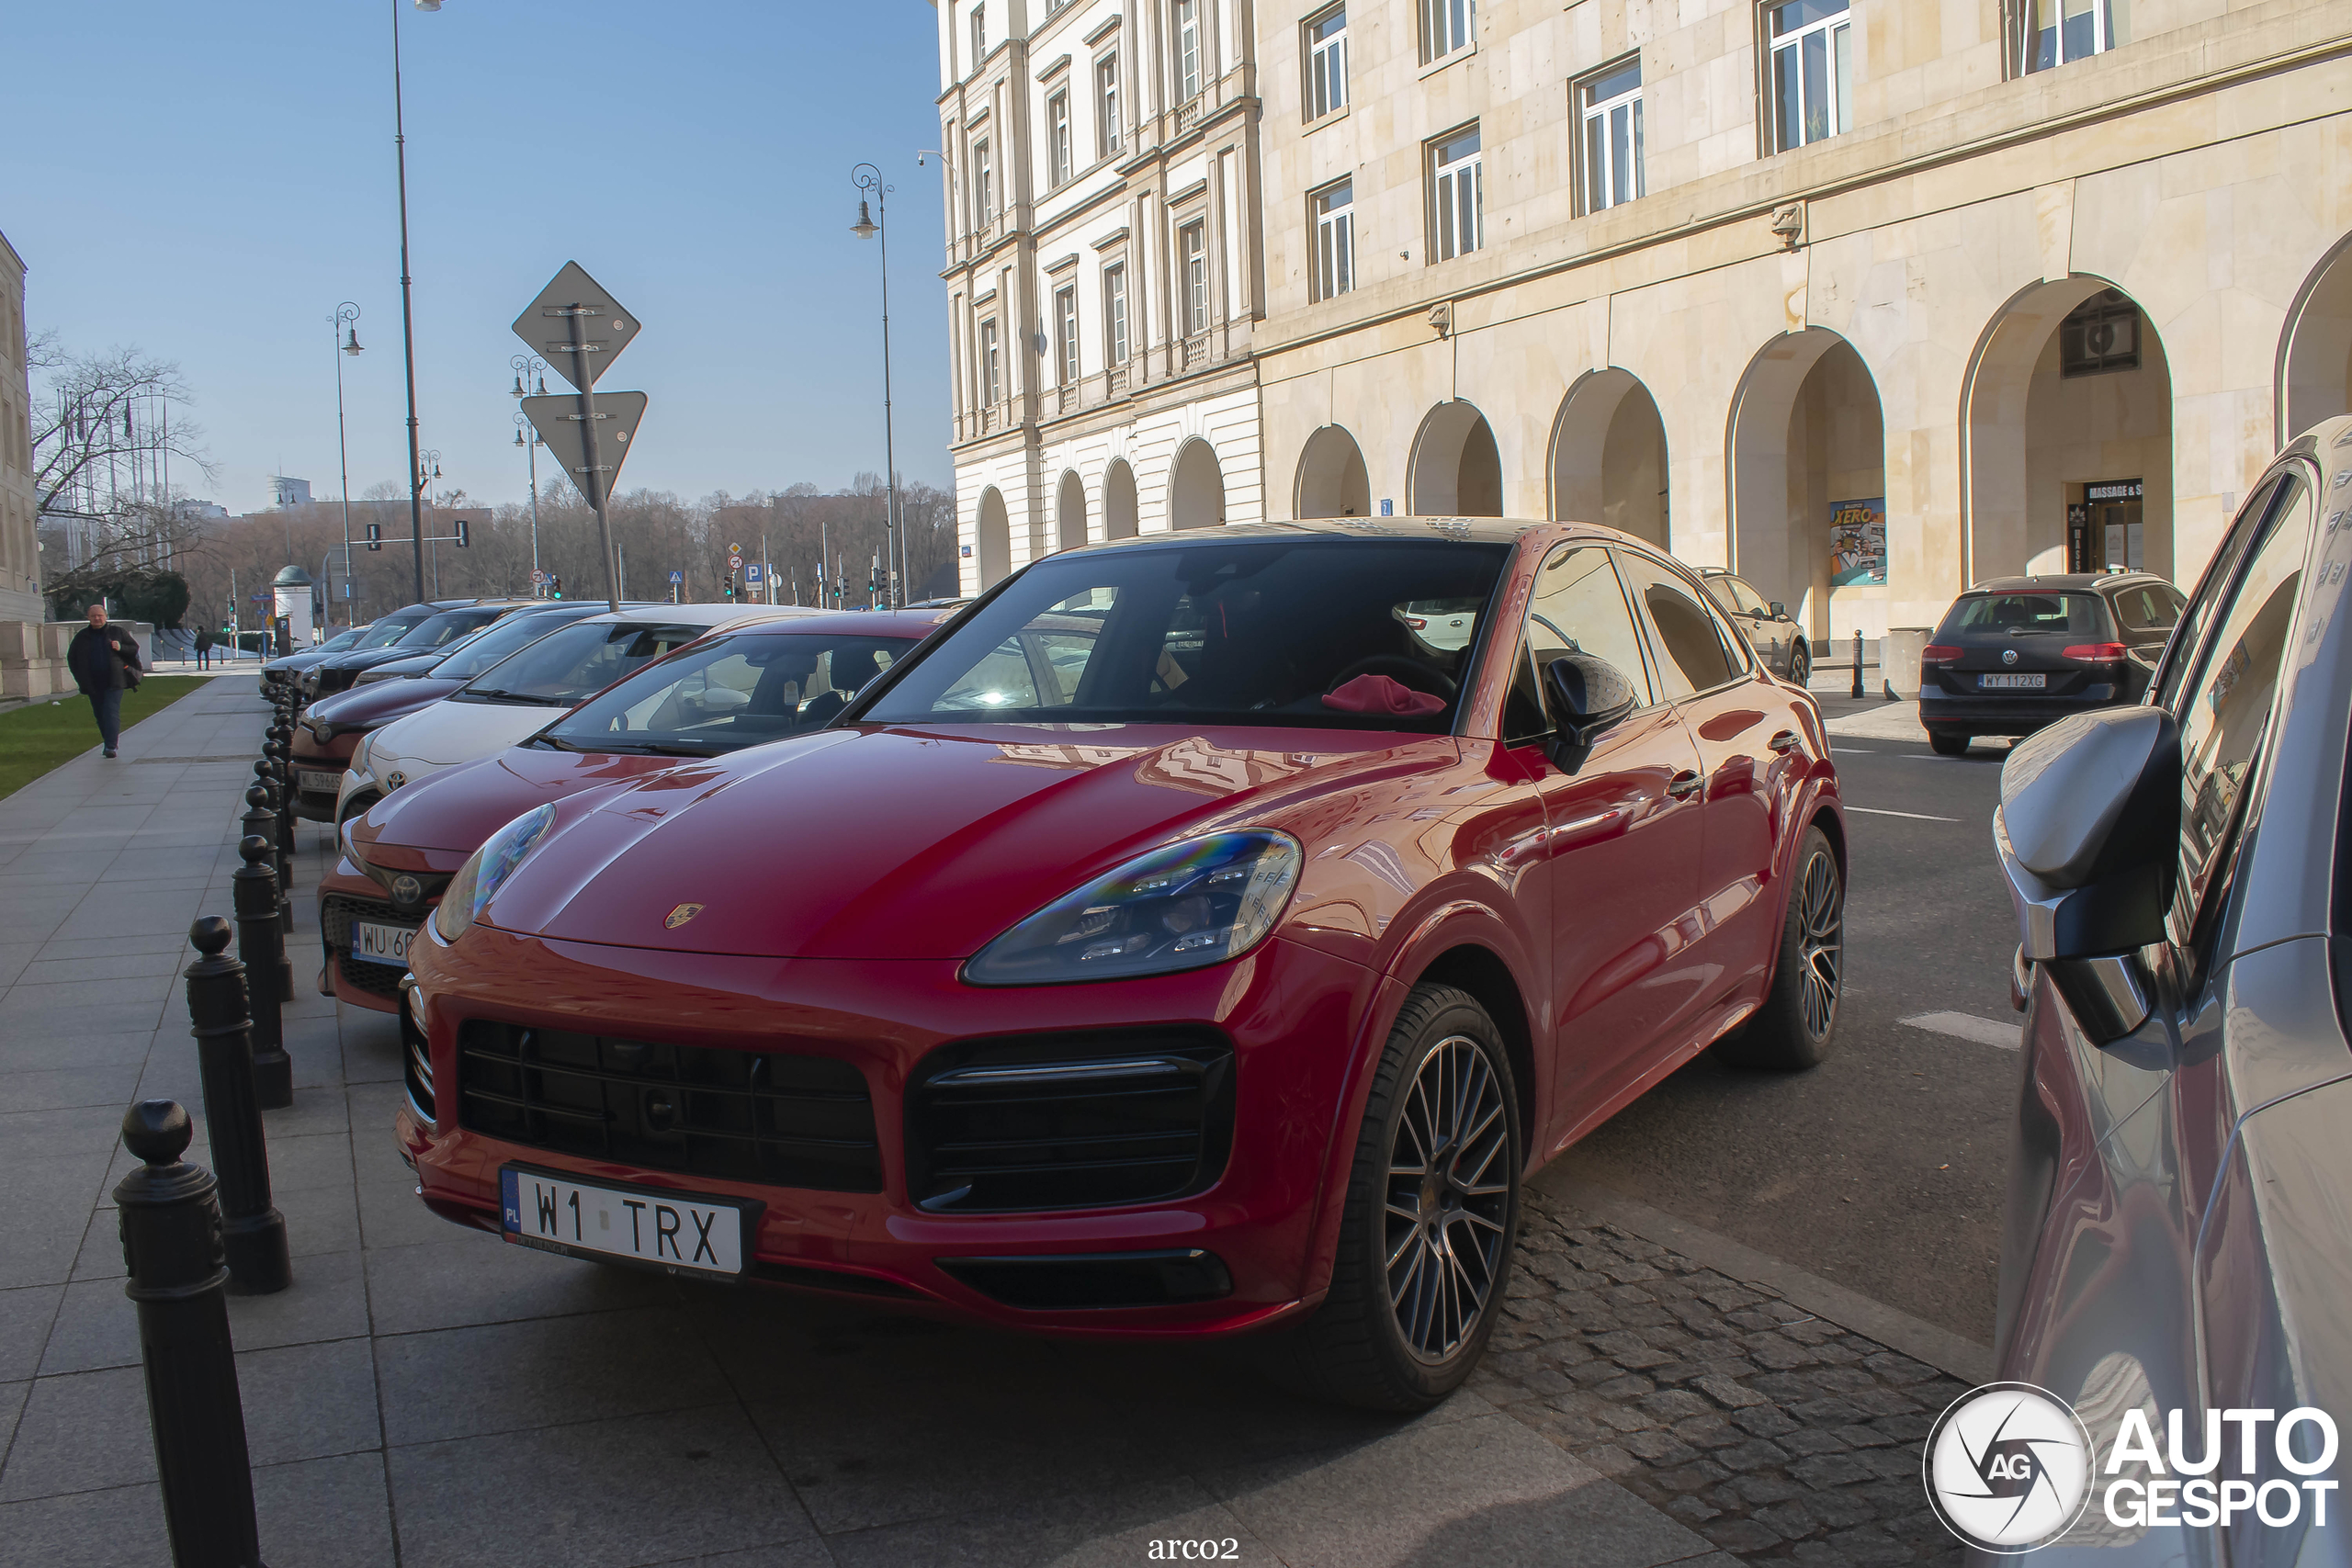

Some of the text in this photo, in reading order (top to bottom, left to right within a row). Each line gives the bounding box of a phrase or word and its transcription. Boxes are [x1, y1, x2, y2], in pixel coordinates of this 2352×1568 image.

[2089, 485, 2127, 499] MASSAGE
[2128, 486, 2135, 496] &
[1835, 508, 1872, 525] XERO
[748, 566, 759, 581] P
[1985, 675, 2043, 686] WY 112XG
[301, 773, 312, 786] WL
[353, 940, 360, 949] PL
[363, 926, 386, 954] WU
[505, 1208, 519, 1224] PL
[535, 1182, 719, 1266] W1 TRX
